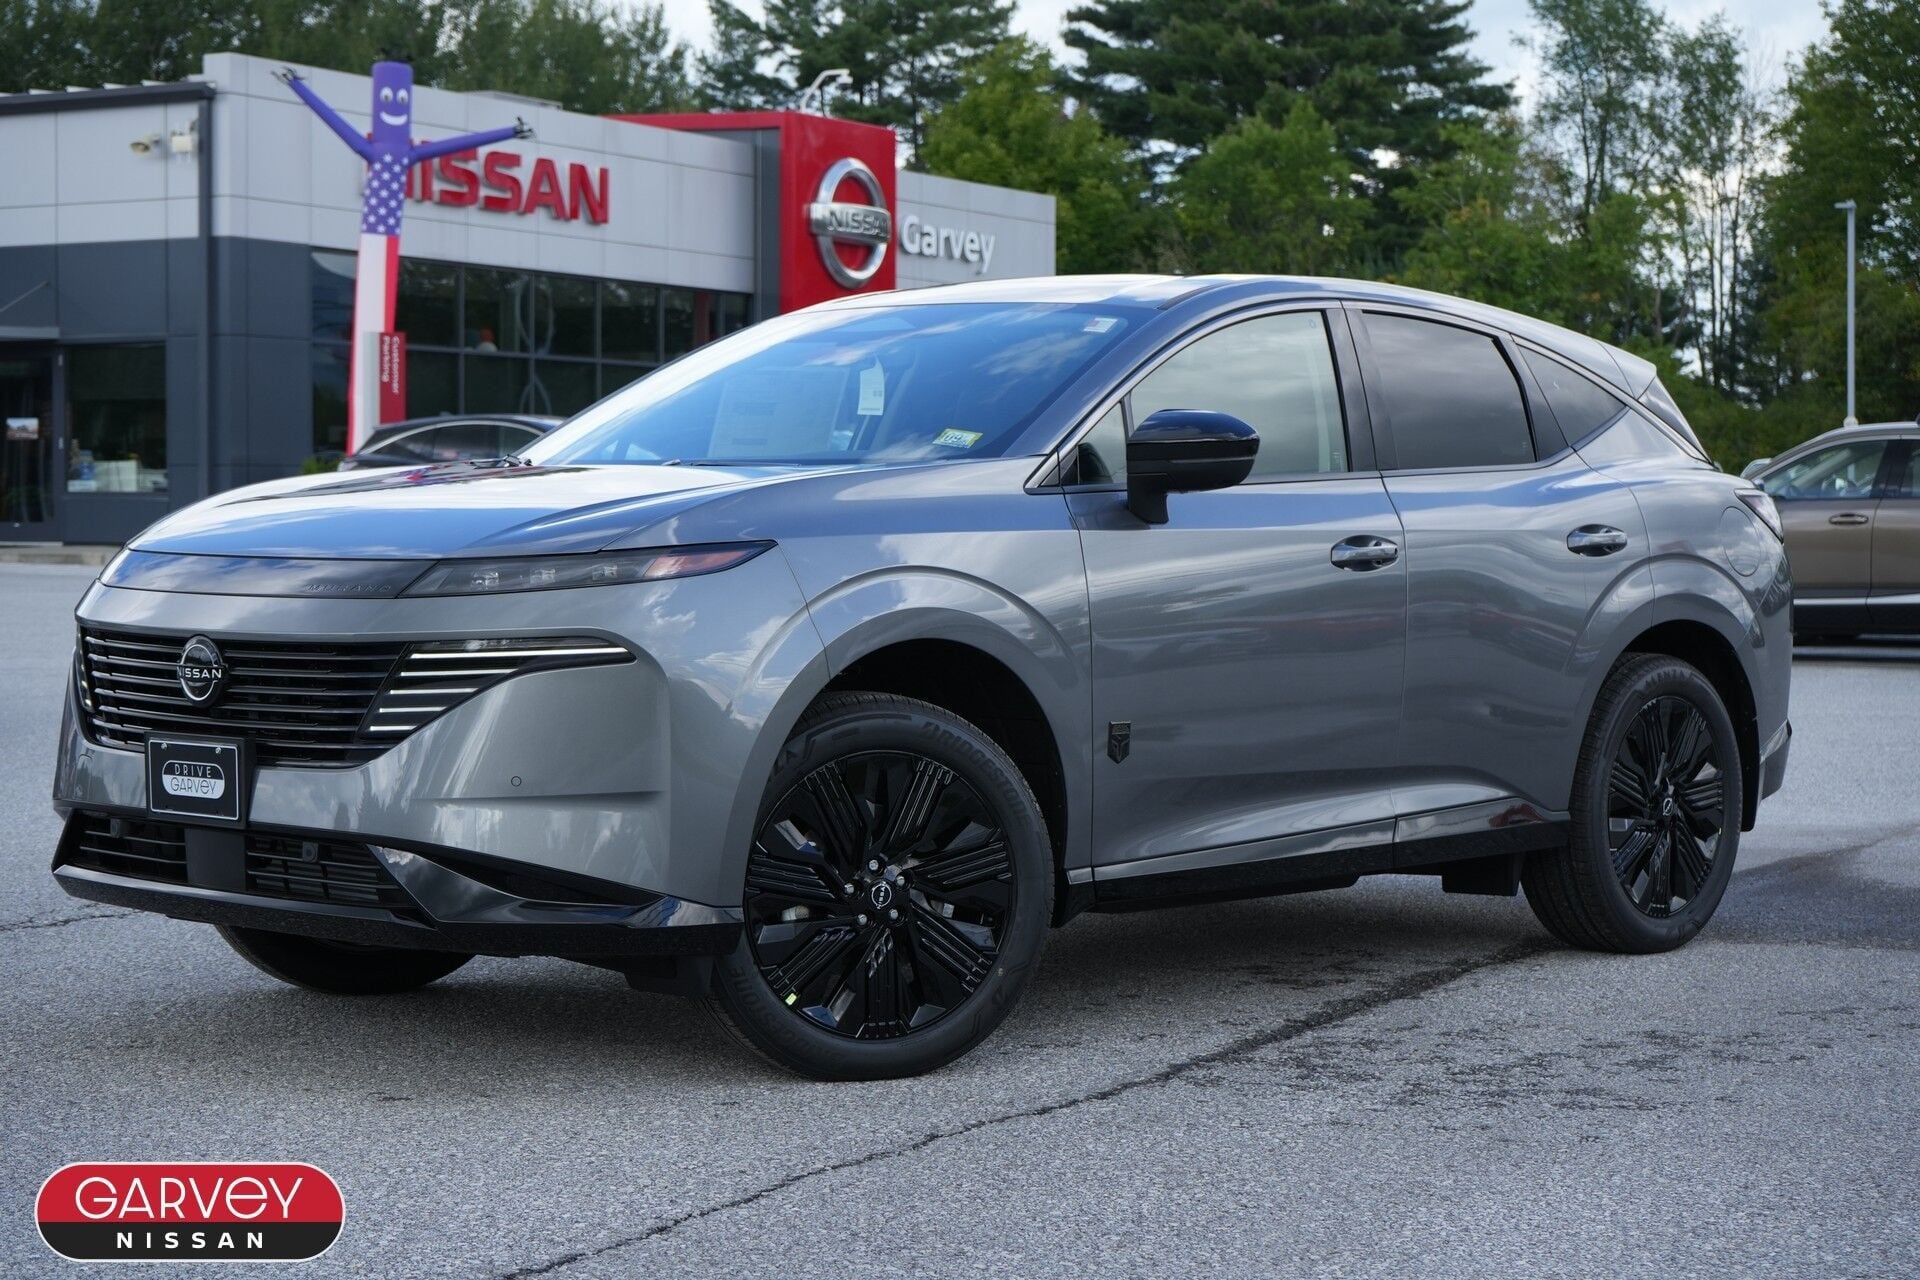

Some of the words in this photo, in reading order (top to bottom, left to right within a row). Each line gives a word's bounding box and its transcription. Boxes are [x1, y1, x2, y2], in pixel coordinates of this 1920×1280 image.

[368, 133, 609, 224] ISSAN
[901, 215, 995, 273] Garvey
[382, 335, 391, 382] Parking
[391, 335, 400, 394] Customer
[177, 666, 222, 679] NISSAN
[174, 764, 212, 778] DRIVE
